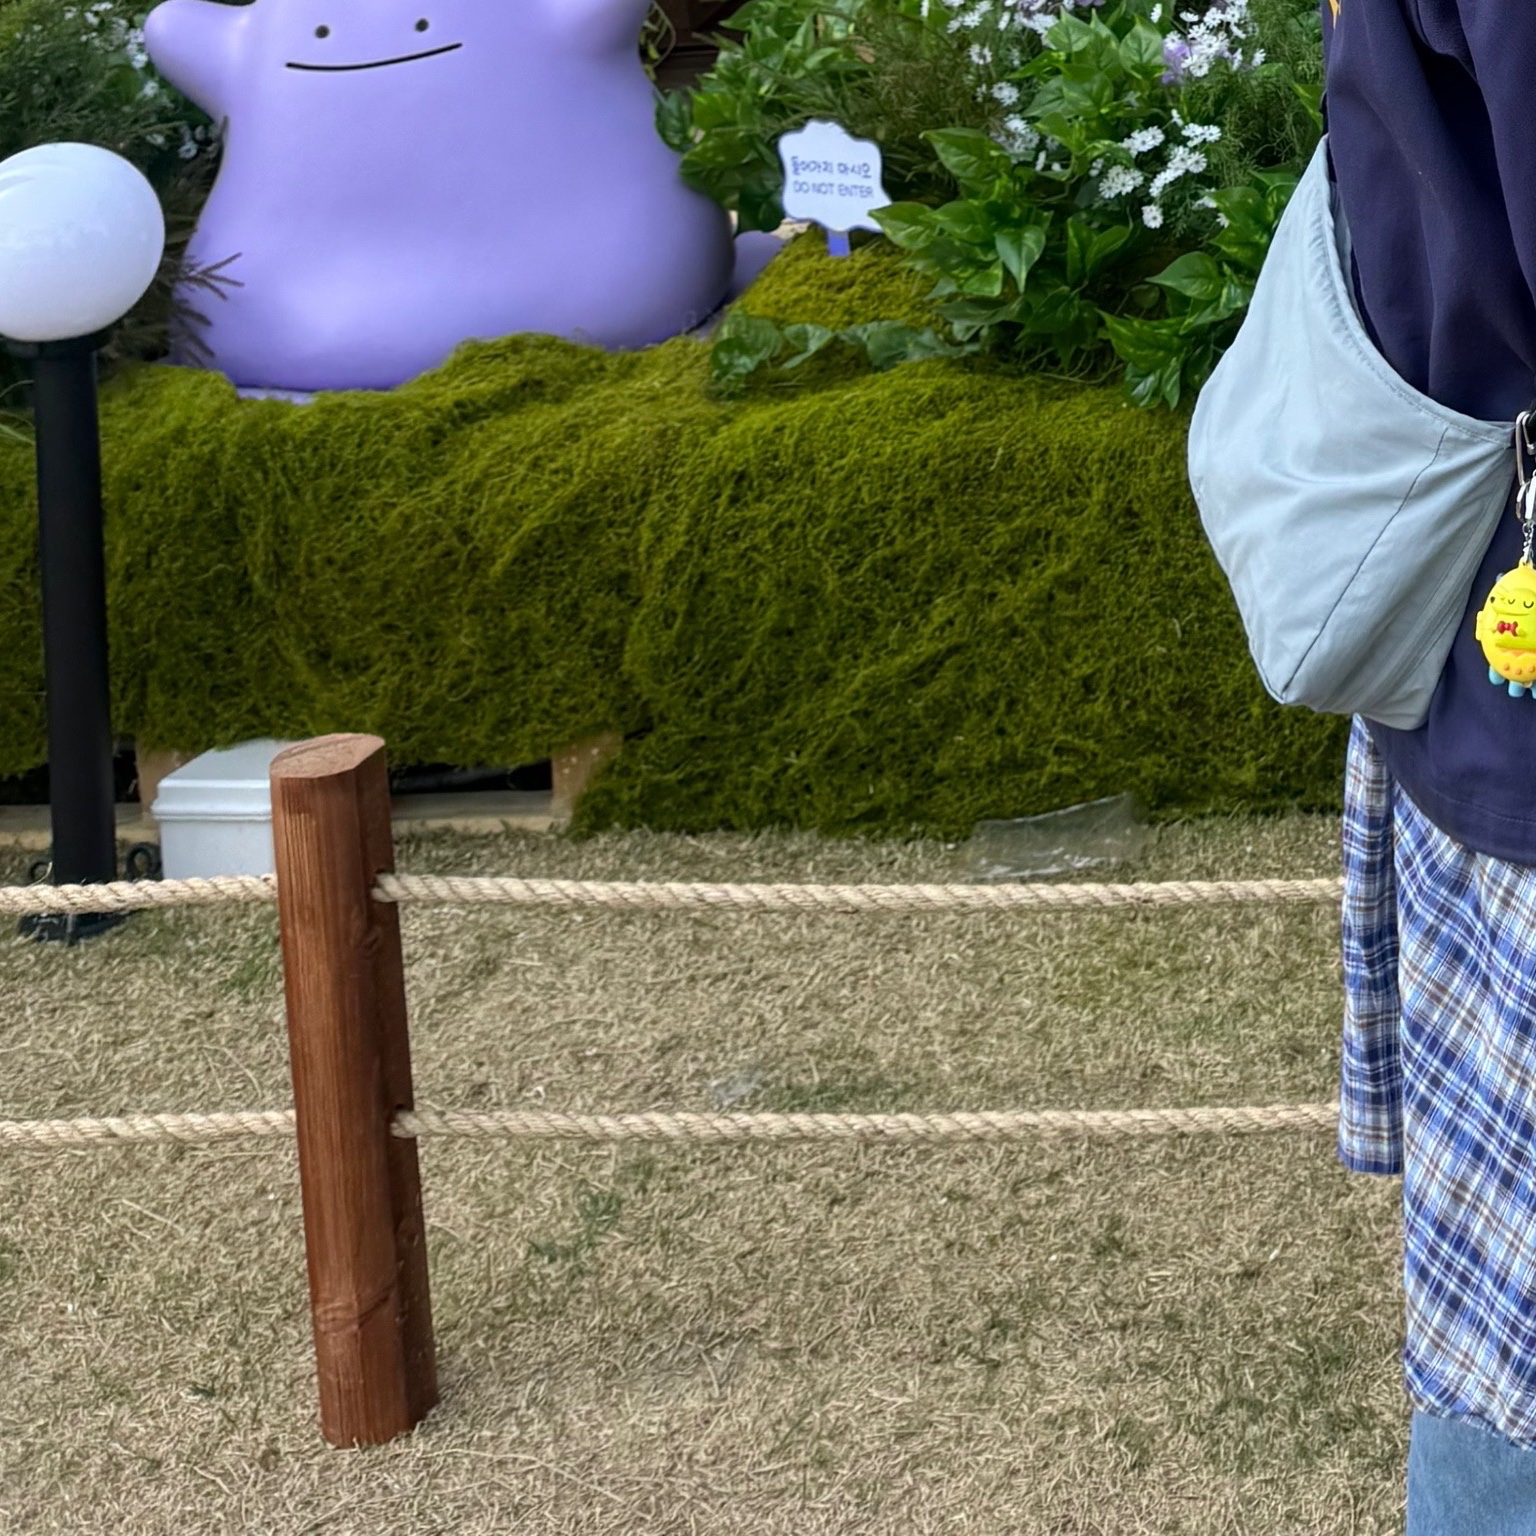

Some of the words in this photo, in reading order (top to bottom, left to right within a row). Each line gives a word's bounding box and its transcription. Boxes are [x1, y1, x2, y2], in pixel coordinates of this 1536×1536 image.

[793, 180, 810, 194] DO
[812, 182, 834, 195] NOT
[838, 183, 874, 199] ENTER
